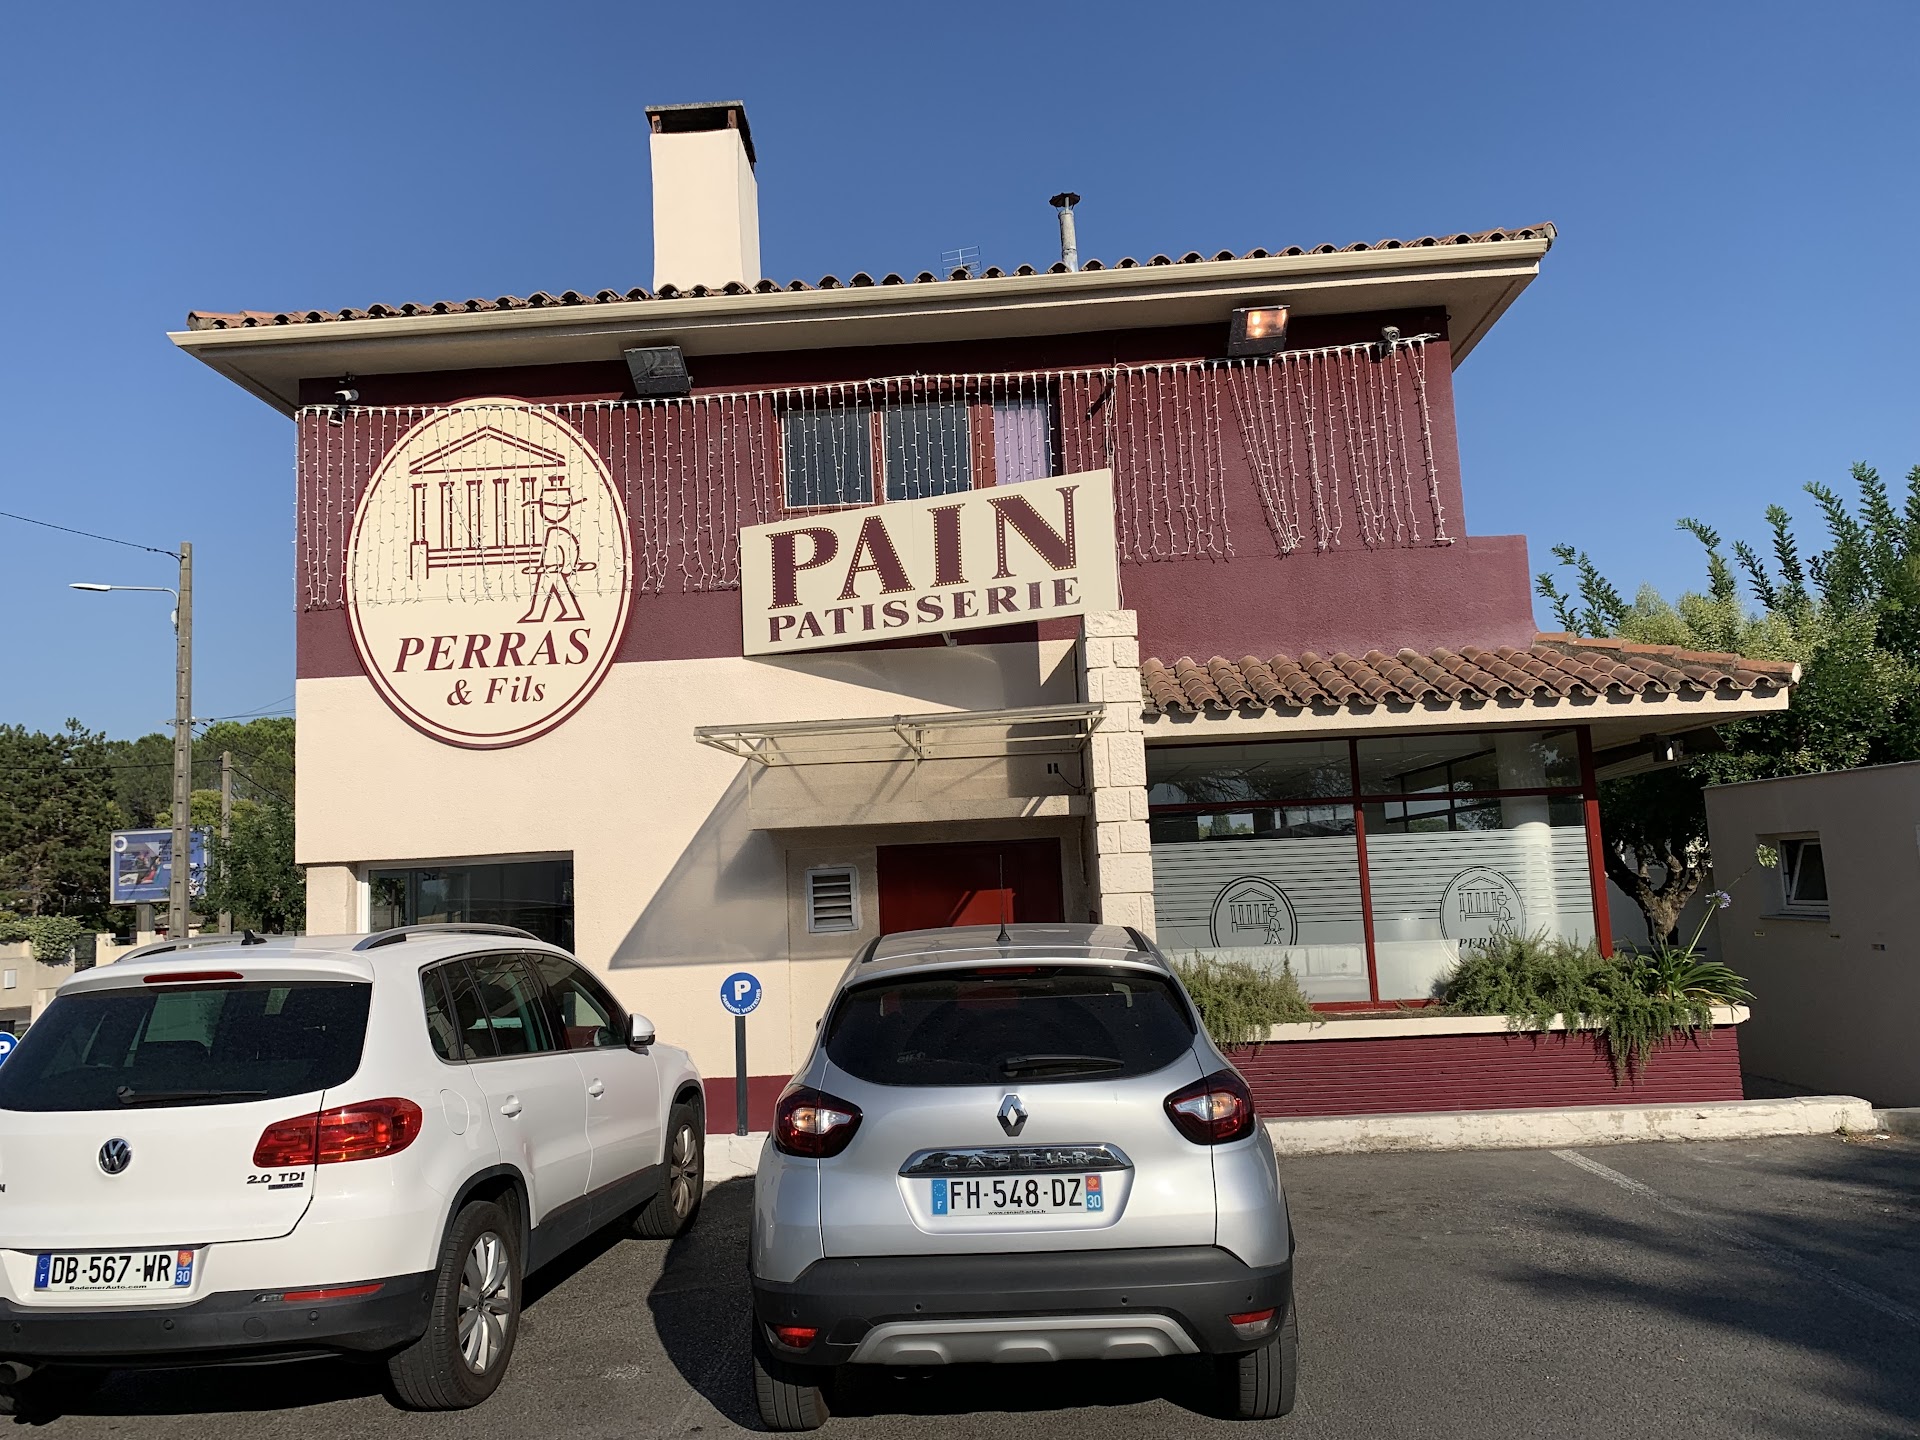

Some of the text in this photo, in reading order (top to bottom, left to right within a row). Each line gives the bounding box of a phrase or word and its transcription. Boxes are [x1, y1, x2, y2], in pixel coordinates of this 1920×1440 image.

[766, 485, 1079, 610] PAIN
[768, 576, 1082, 643] PATISSERIE
[392, 628, 591, 673] PERRAS
[446, 675, 546, 706] & Fils
[734, 980, 751, 1001] P
[722, 994, 741, 1013] PARKING
[942, 1151, 1090, 1169] CAPTUR
[247, 1172, 305, 1184] 2.0 TDI
[950, 1178, 1082, 1209] FH-548-DZ
[1087, 1194, 1101, 1208] 30
[937, 1201, 943, 1210] F
[39, 1273, 46, 1282] F
[176, 1270, 190, 1283] 30
